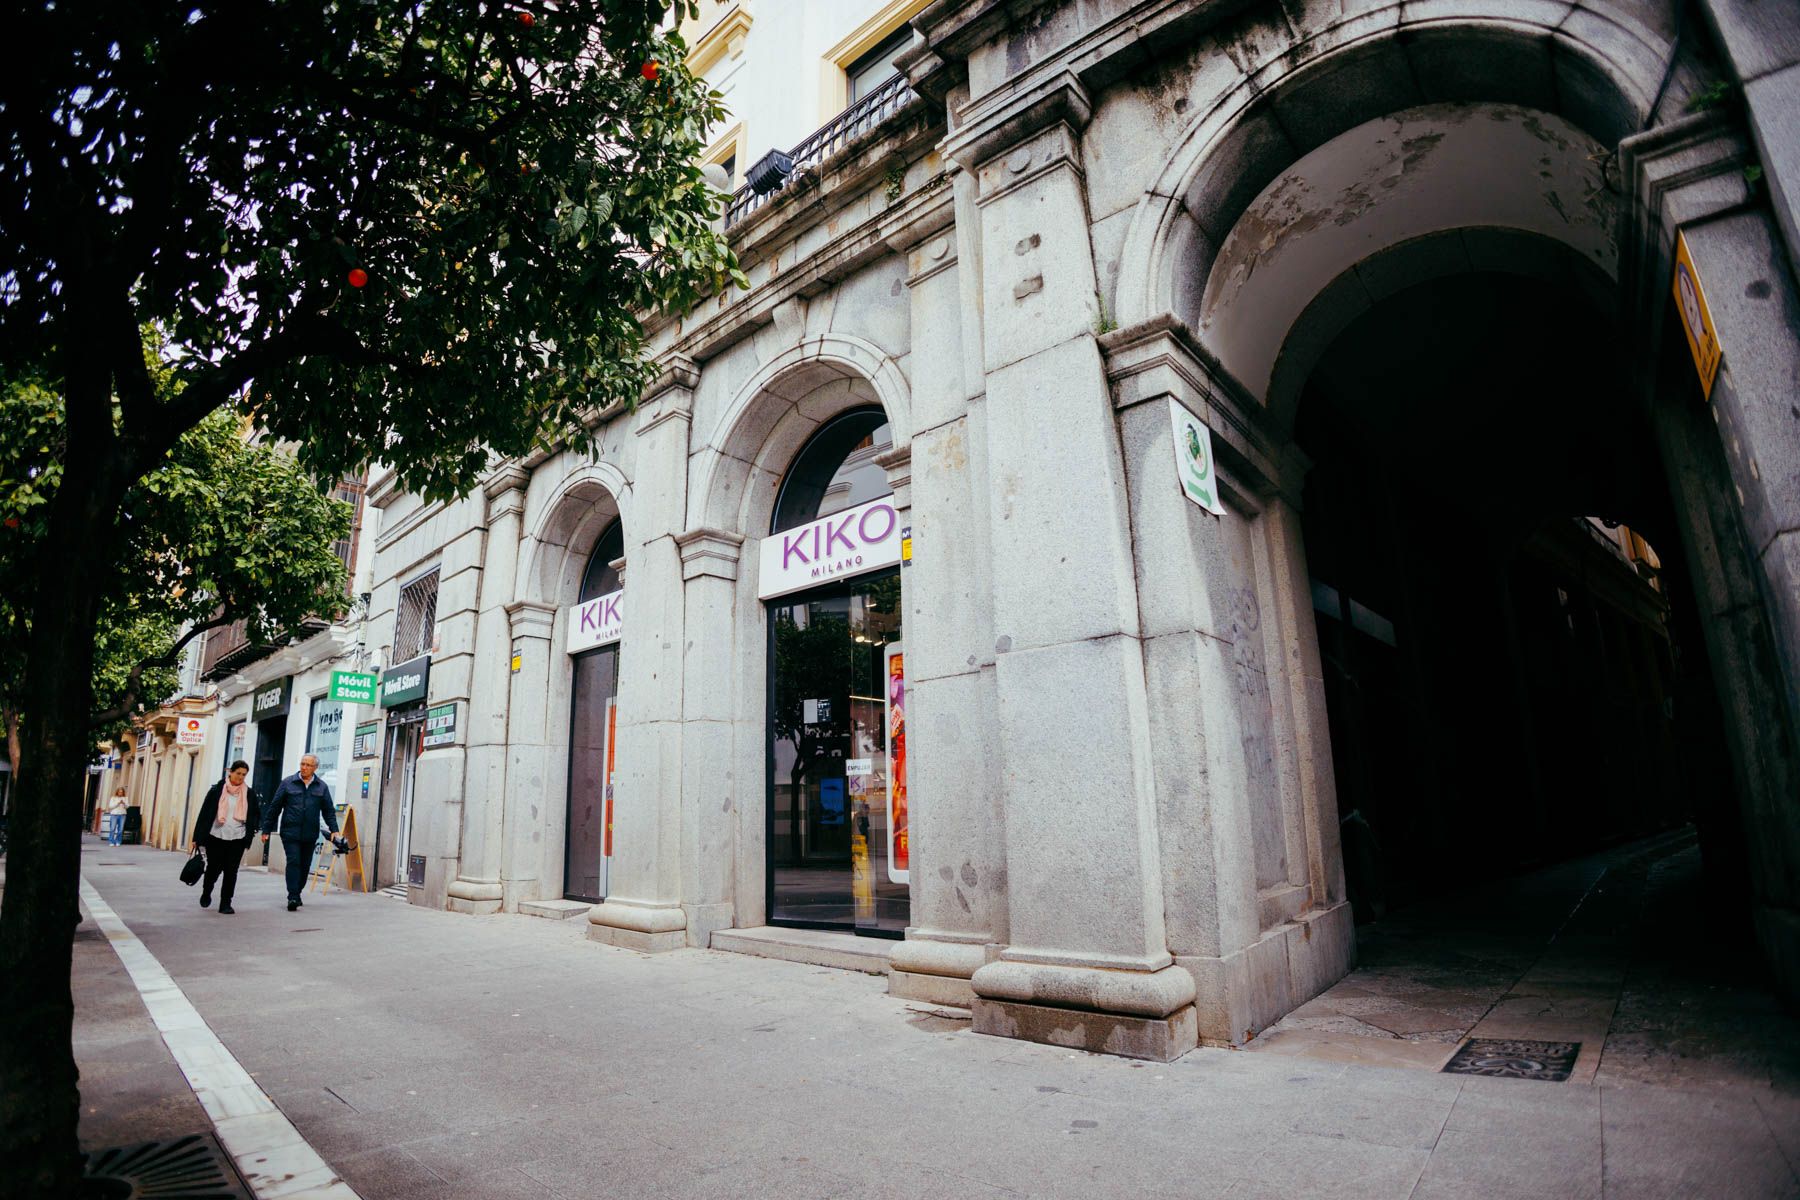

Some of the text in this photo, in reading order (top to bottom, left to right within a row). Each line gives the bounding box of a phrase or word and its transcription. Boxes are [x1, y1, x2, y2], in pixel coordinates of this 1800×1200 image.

[783, 504, 896, 570] KIKO
[811, 555, 863, 578] MILANO
[580, 593, 622, 633] KIK
[595, 628, 622, 640] MILAN
[336, 687, 370, 699] Store
[338, 675, 372, 688] Móvil
[384, 673, 421, 696] Móvil Store
[256, 687, 282, 711] TIGER
